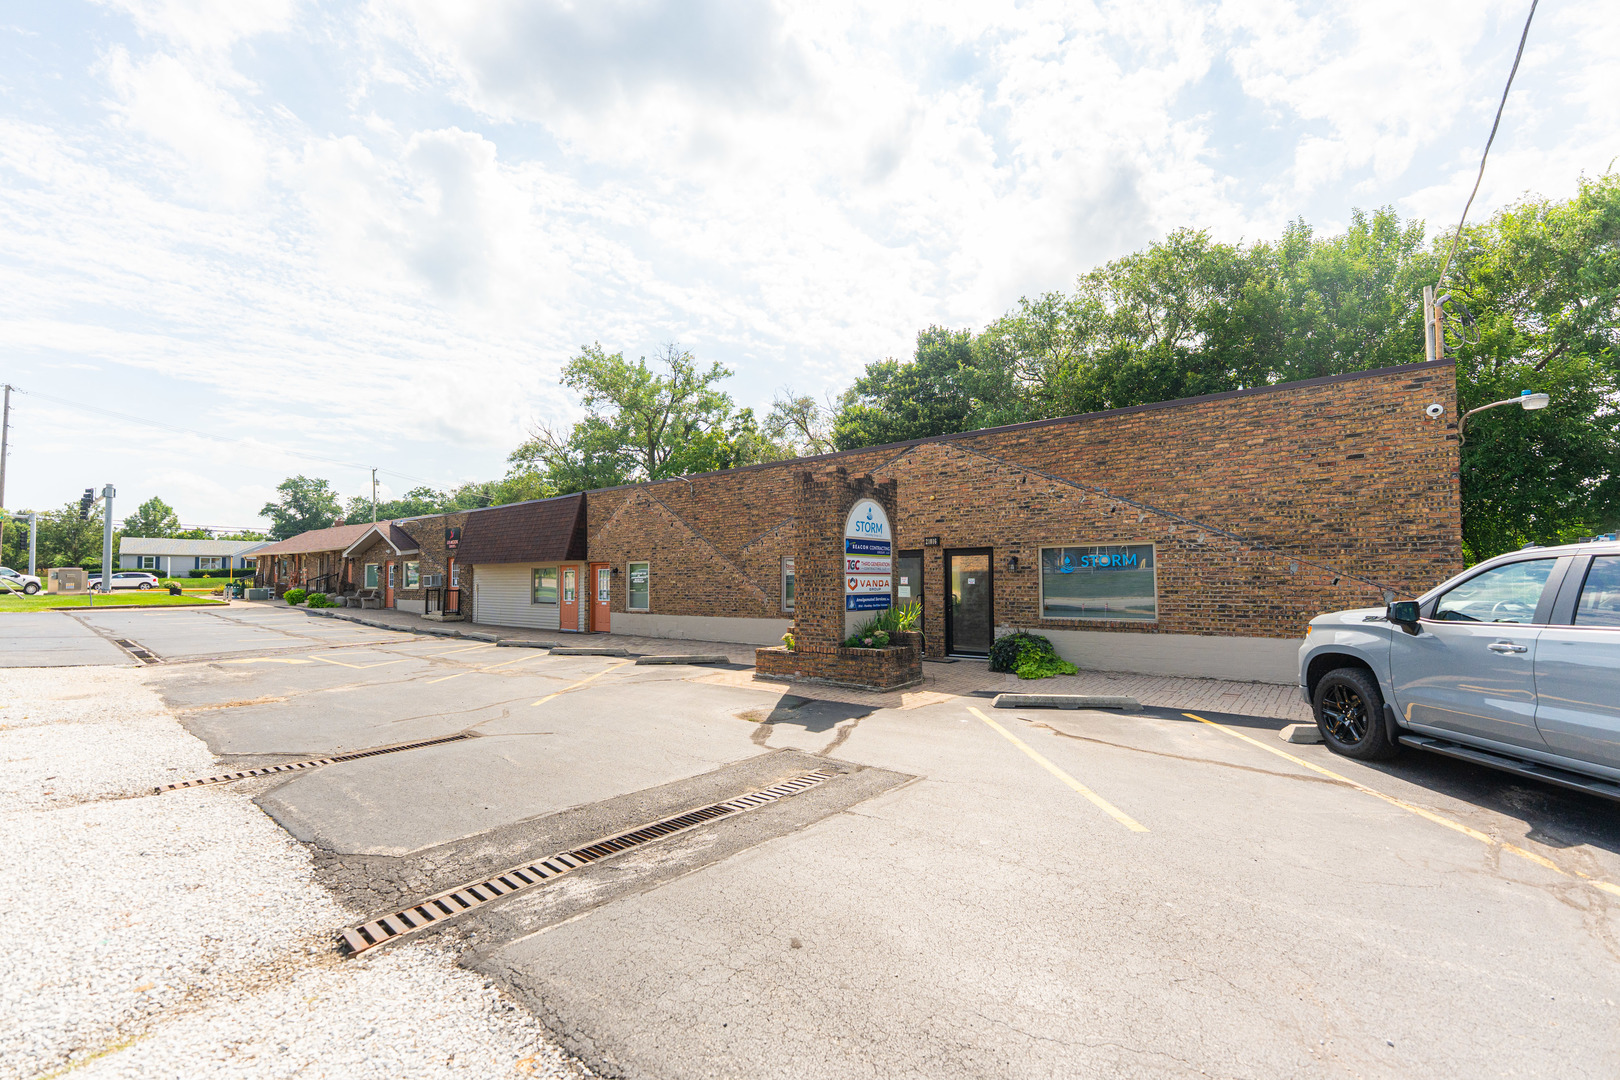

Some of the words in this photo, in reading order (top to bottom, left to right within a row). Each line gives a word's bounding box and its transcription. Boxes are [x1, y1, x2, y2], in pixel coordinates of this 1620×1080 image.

[855, 521, 882, 534] STORM
[847, 560, 860, 570] TGC
[1081, 553, 1137, 568] STORM
